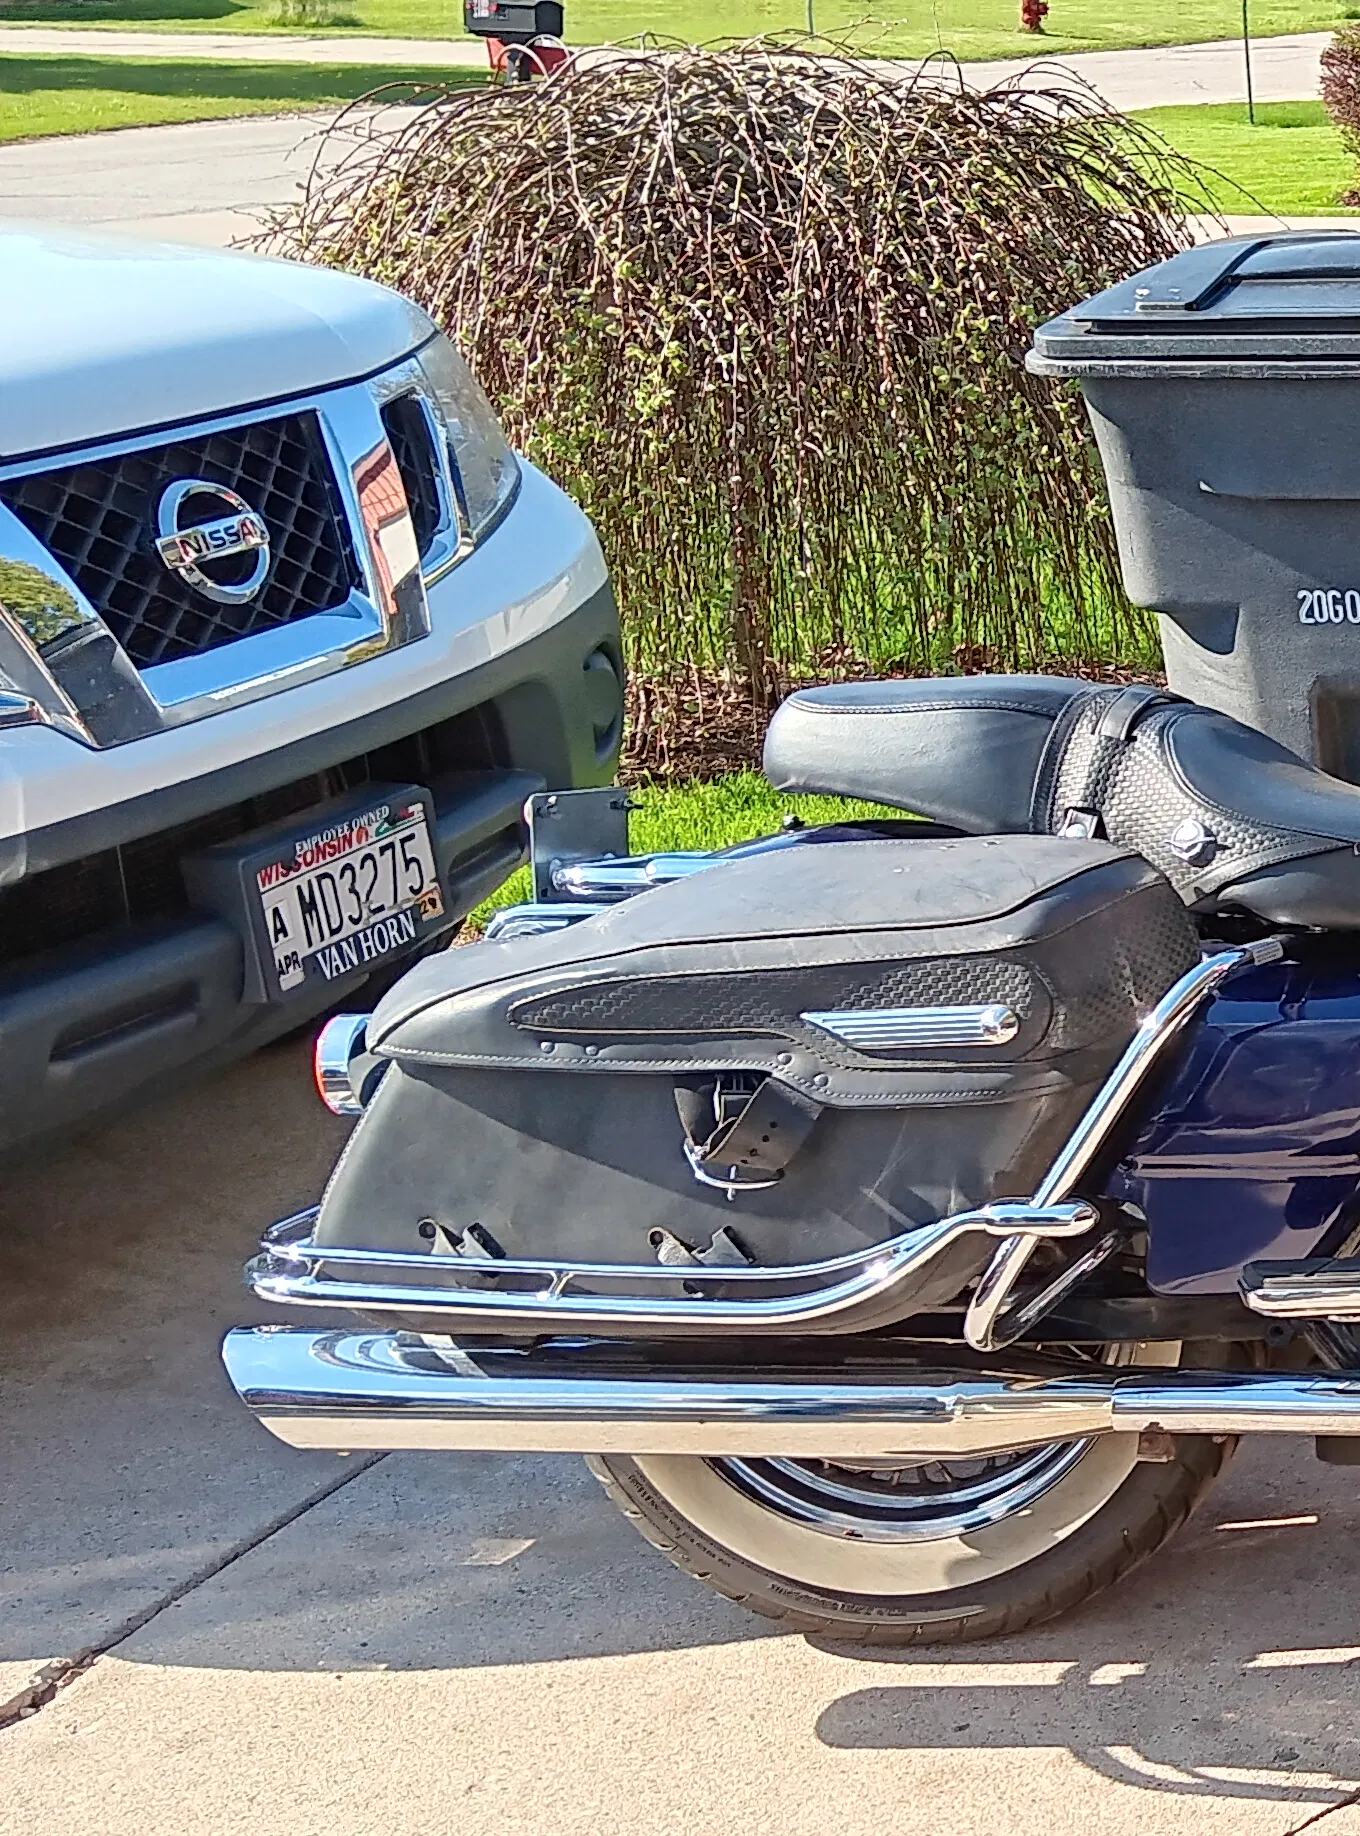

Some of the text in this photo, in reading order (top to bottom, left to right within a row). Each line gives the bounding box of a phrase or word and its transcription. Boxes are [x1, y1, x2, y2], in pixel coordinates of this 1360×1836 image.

[295, 805, 390, 854] EMPLOYEE OWNED
[296, 832, 424, 948] MD3275
[271, 906, 289, 944] A
[317, 910, 416, 981] VAN HORN
[278, 950, 301, 976] APR
